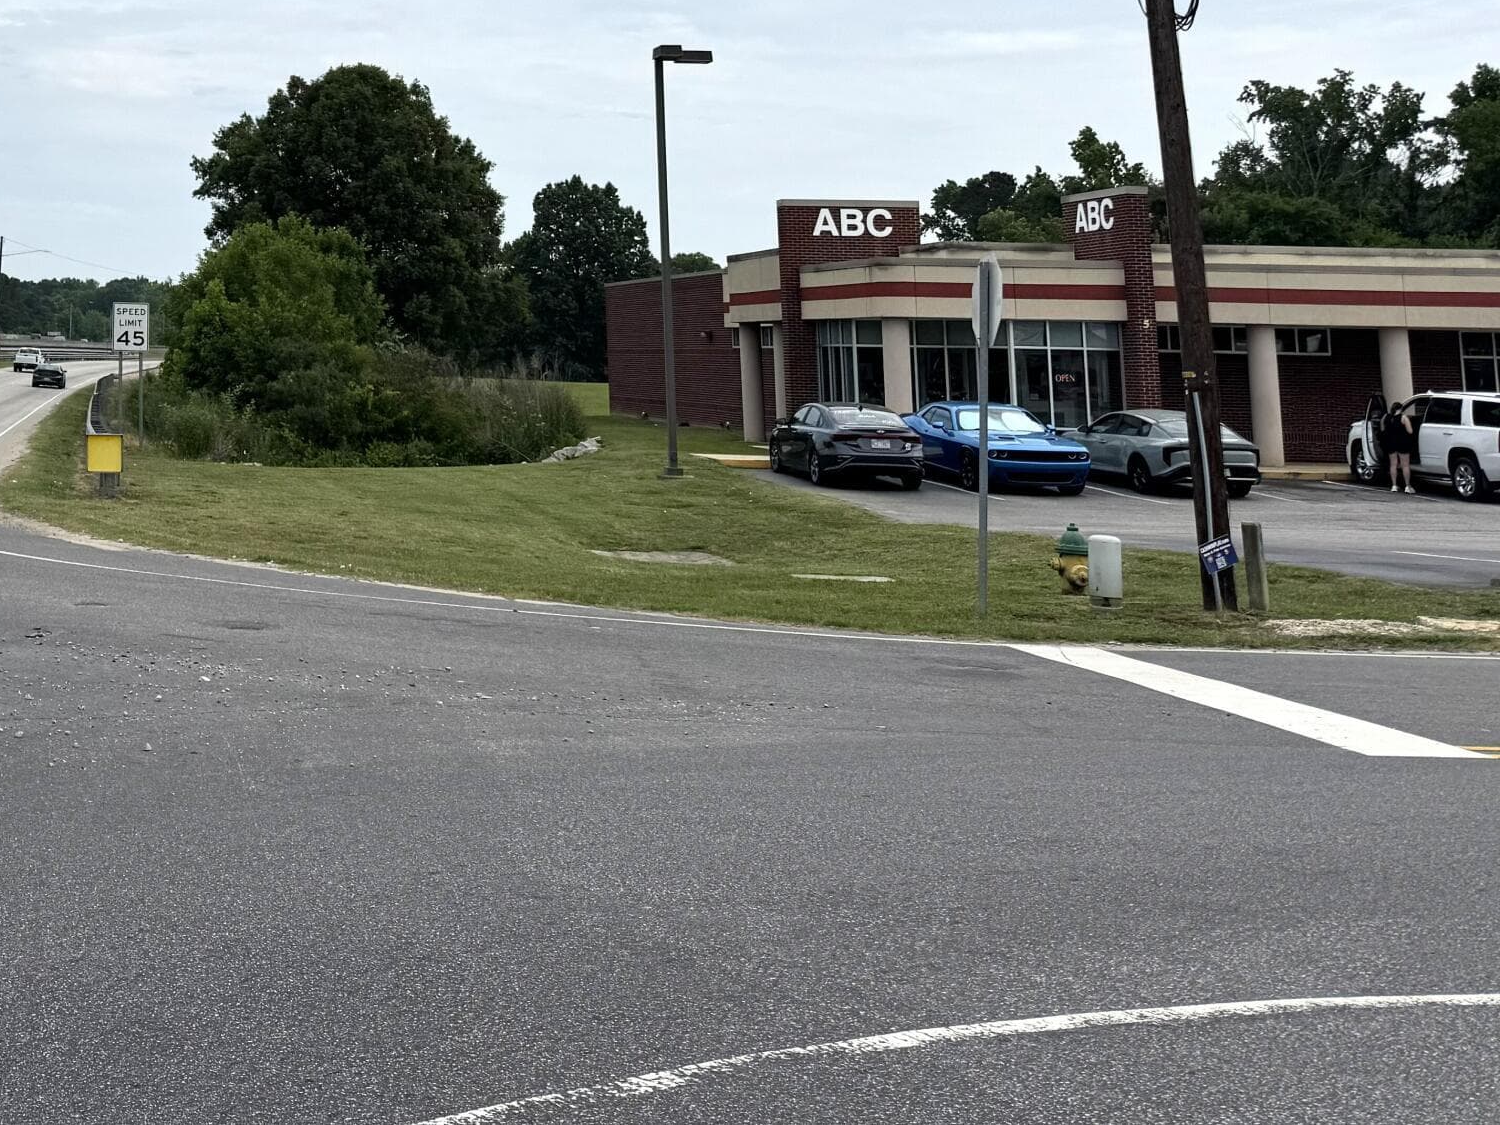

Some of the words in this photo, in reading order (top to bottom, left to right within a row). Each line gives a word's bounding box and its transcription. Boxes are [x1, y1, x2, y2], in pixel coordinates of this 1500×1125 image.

[1075, 198, 1115, 234] ABC
[812, 208, 893, 238] ABC
[116, 308, 146, 316] SPEED
[119, 319, 143, 327] LIMIT
[116, 330, 145, 346] 45
[1055, 373, 1076, 382] OPEN
